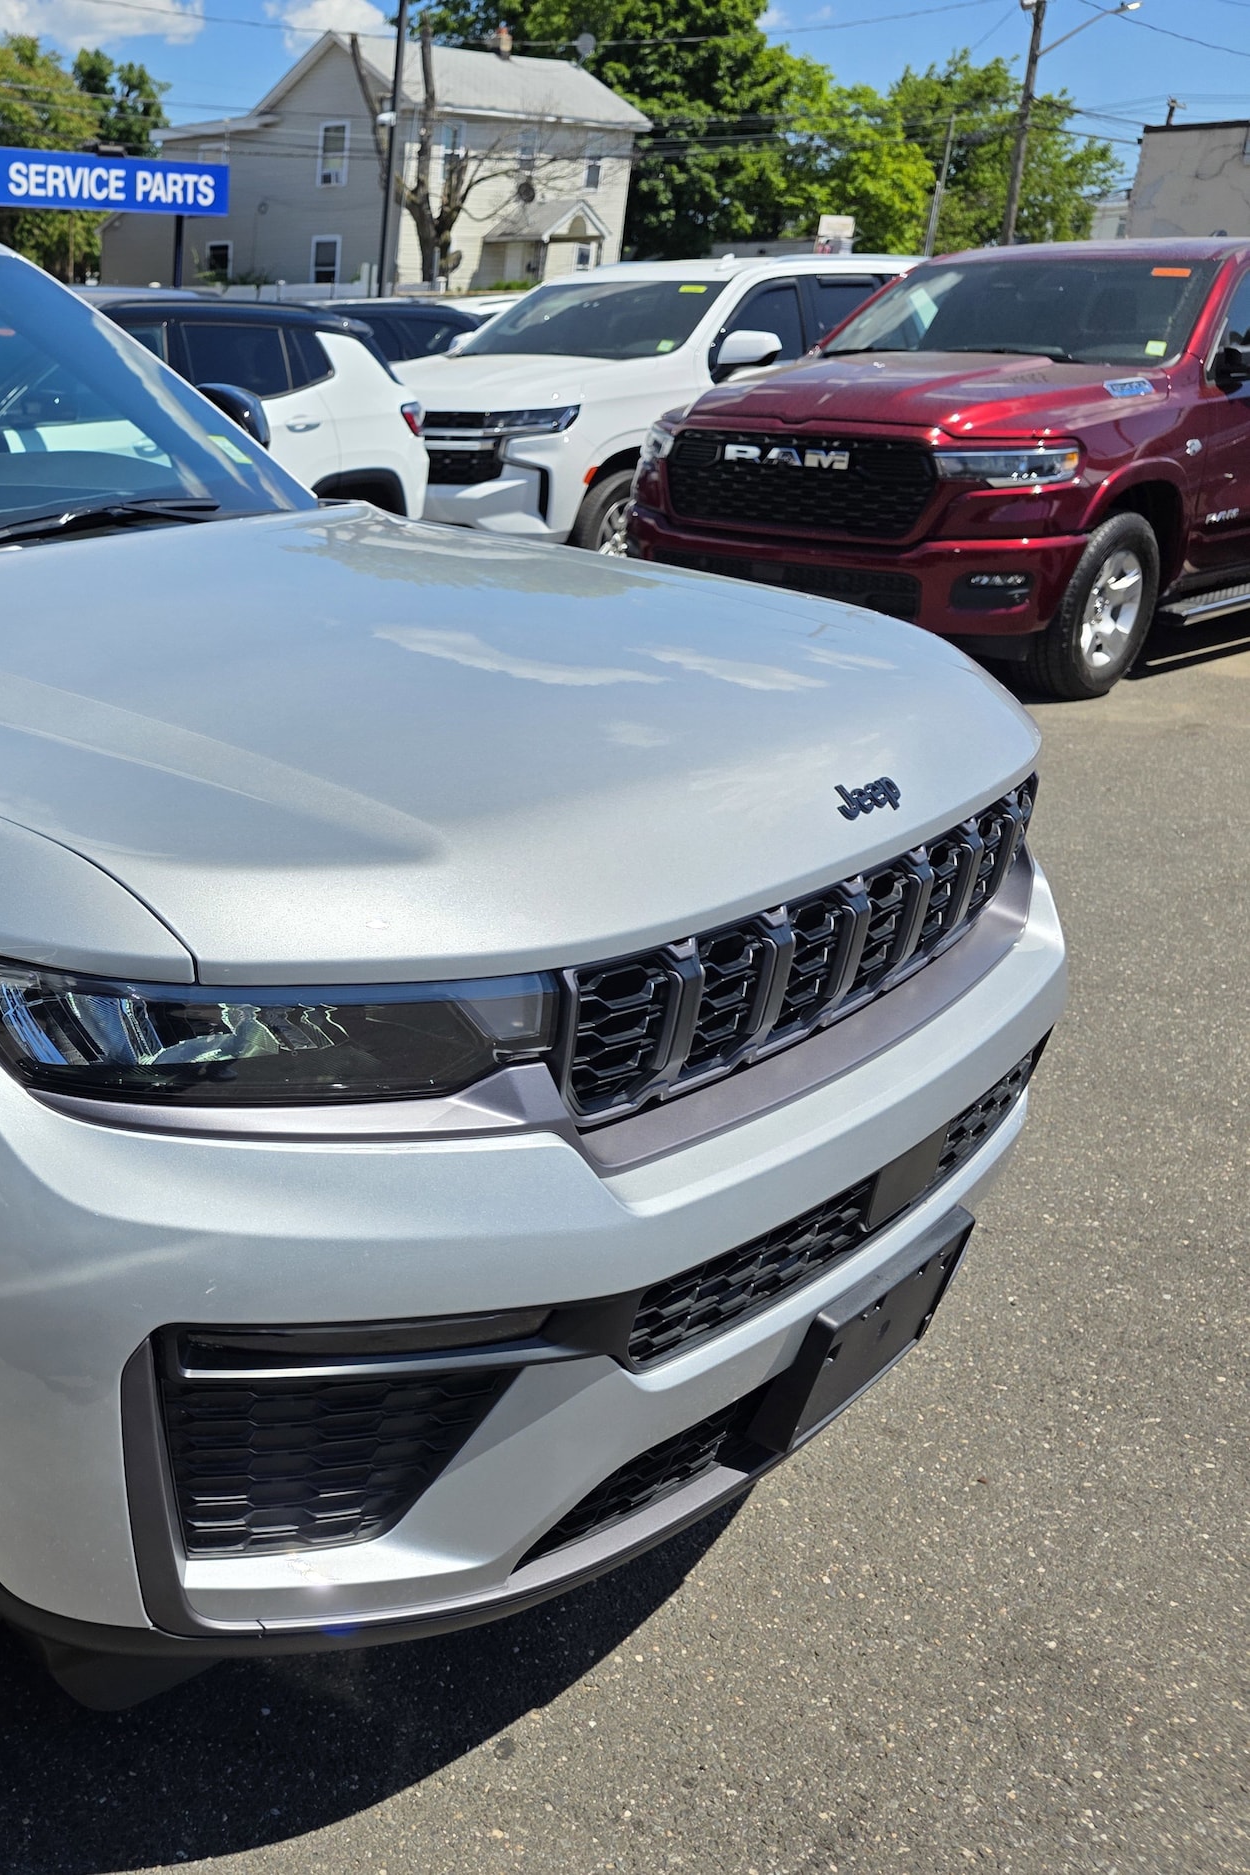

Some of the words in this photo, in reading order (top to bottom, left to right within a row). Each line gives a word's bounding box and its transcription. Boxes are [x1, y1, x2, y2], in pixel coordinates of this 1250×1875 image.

[8, 161, 126, 201] SERVICE
[136, 170, 215, 207] PARTS
[724, 443, 850, 471] RAM
[834, 776, 902, 821] Jeep
